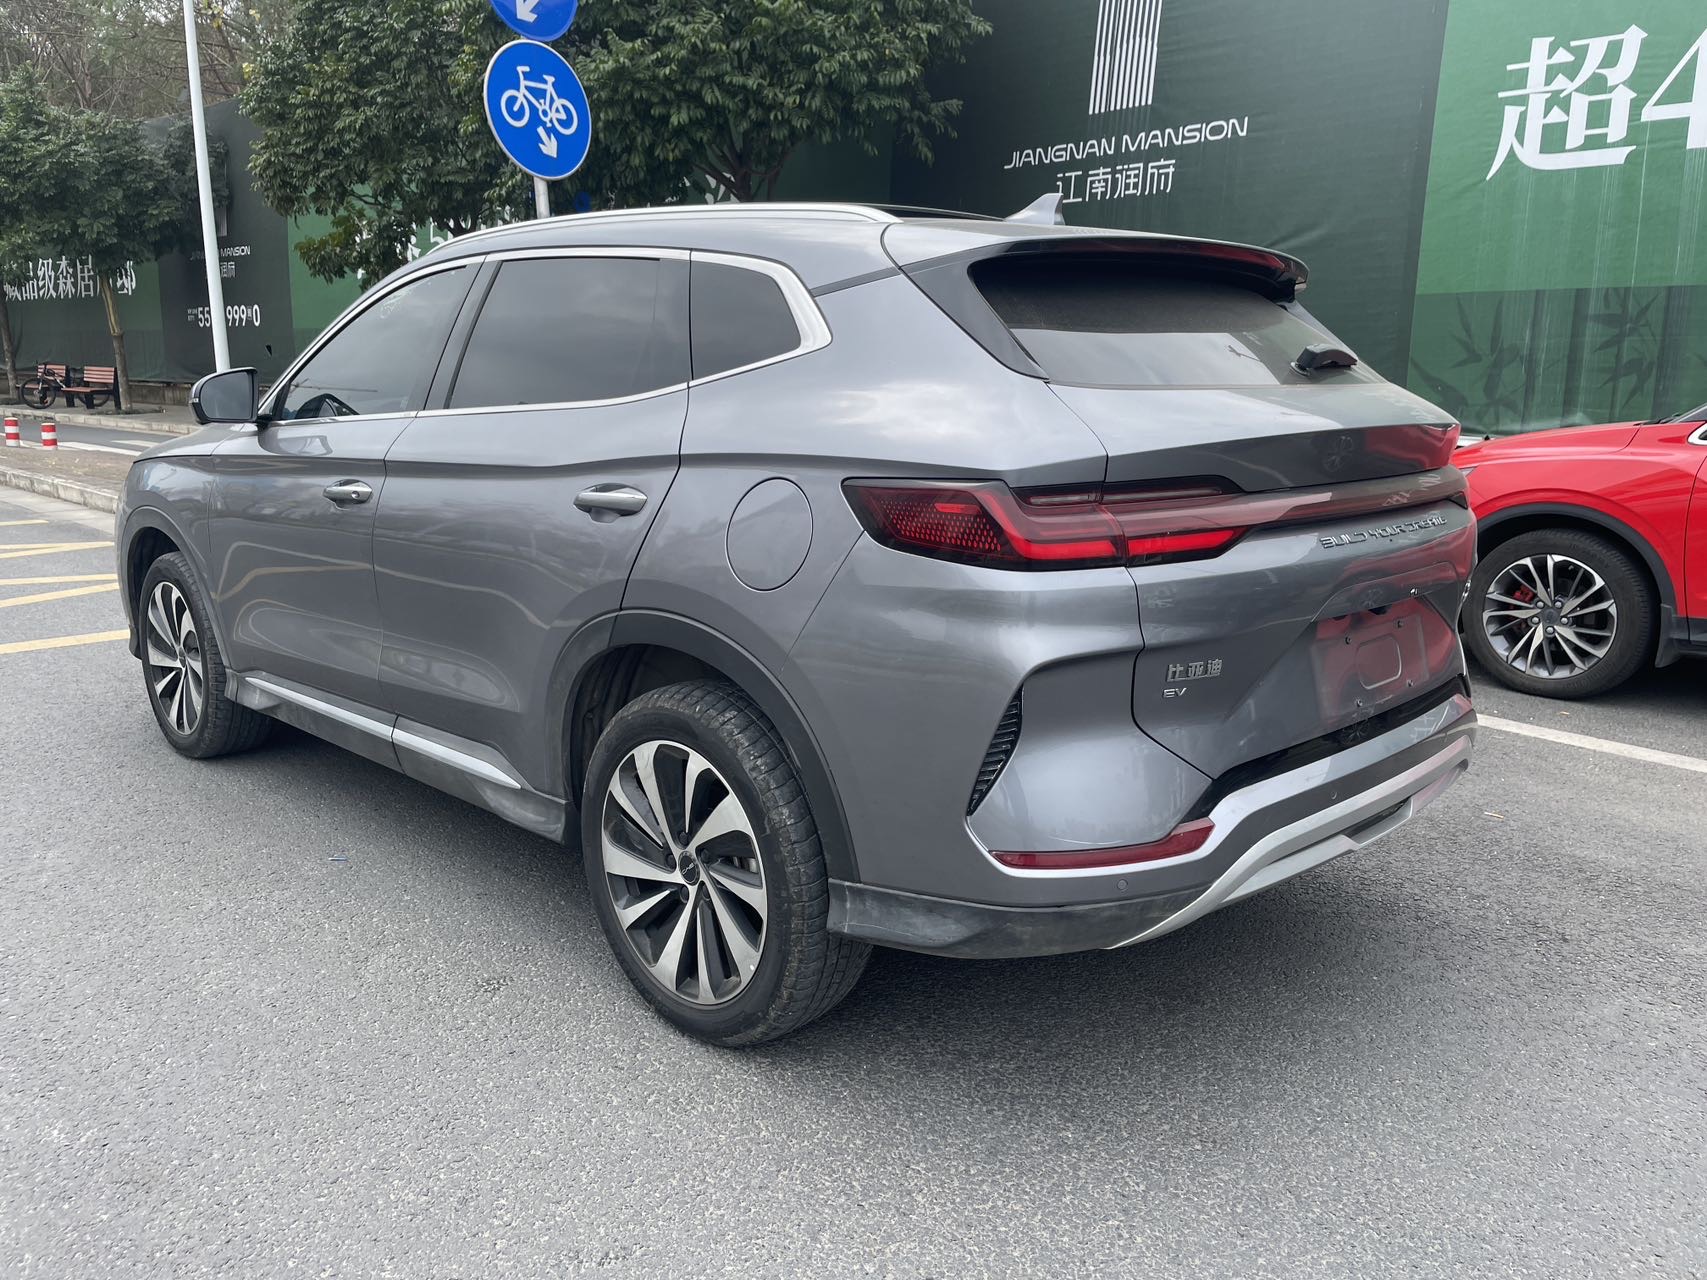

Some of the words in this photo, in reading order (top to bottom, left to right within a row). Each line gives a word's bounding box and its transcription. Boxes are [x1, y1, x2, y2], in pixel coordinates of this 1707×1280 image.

[1004, 136, 1116, 170] JIANGNAN
[1122, 116, 1249, 153] MANSION
[1056, 158, 1176, 204] 江南润府
[1166, 658, 1223, 682] 比亚迪
[1163, 687, 1187, 699] EV
